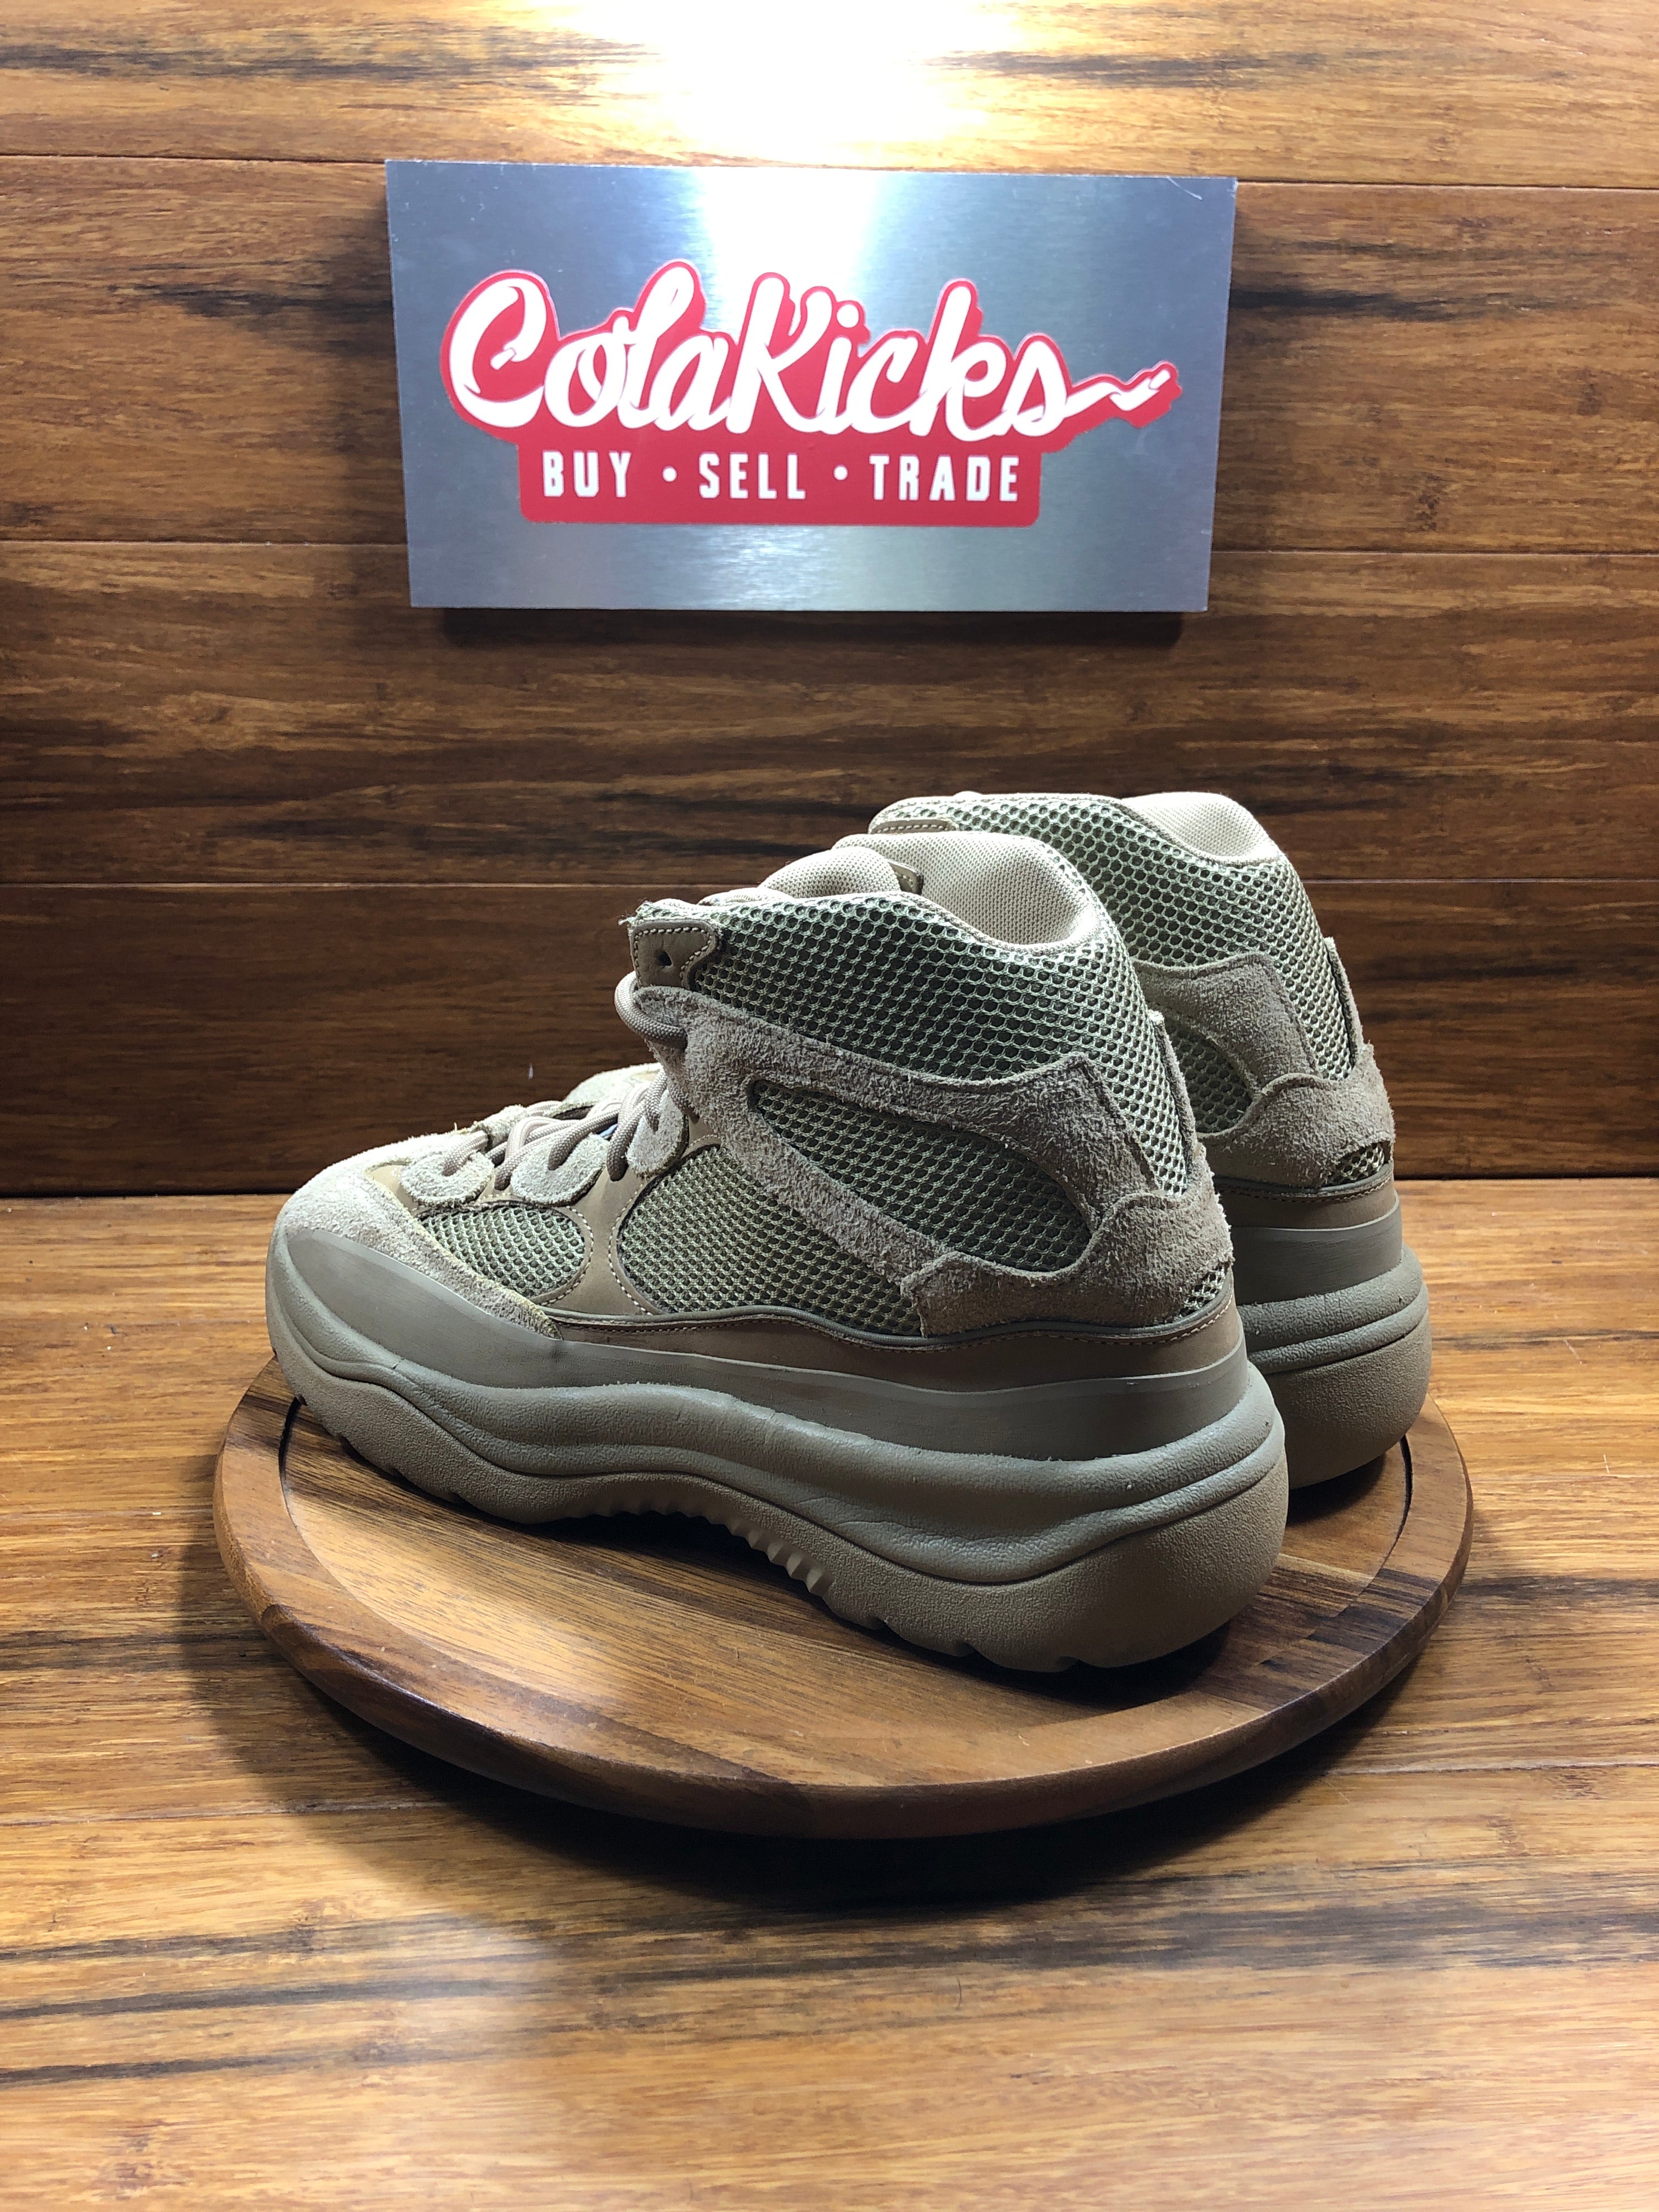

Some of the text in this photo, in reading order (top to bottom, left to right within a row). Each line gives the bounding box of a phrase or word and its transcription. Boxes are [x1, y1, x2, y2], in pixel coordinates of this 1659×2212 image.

[542, 451, 1020, 502] BUY SELL TRADE
